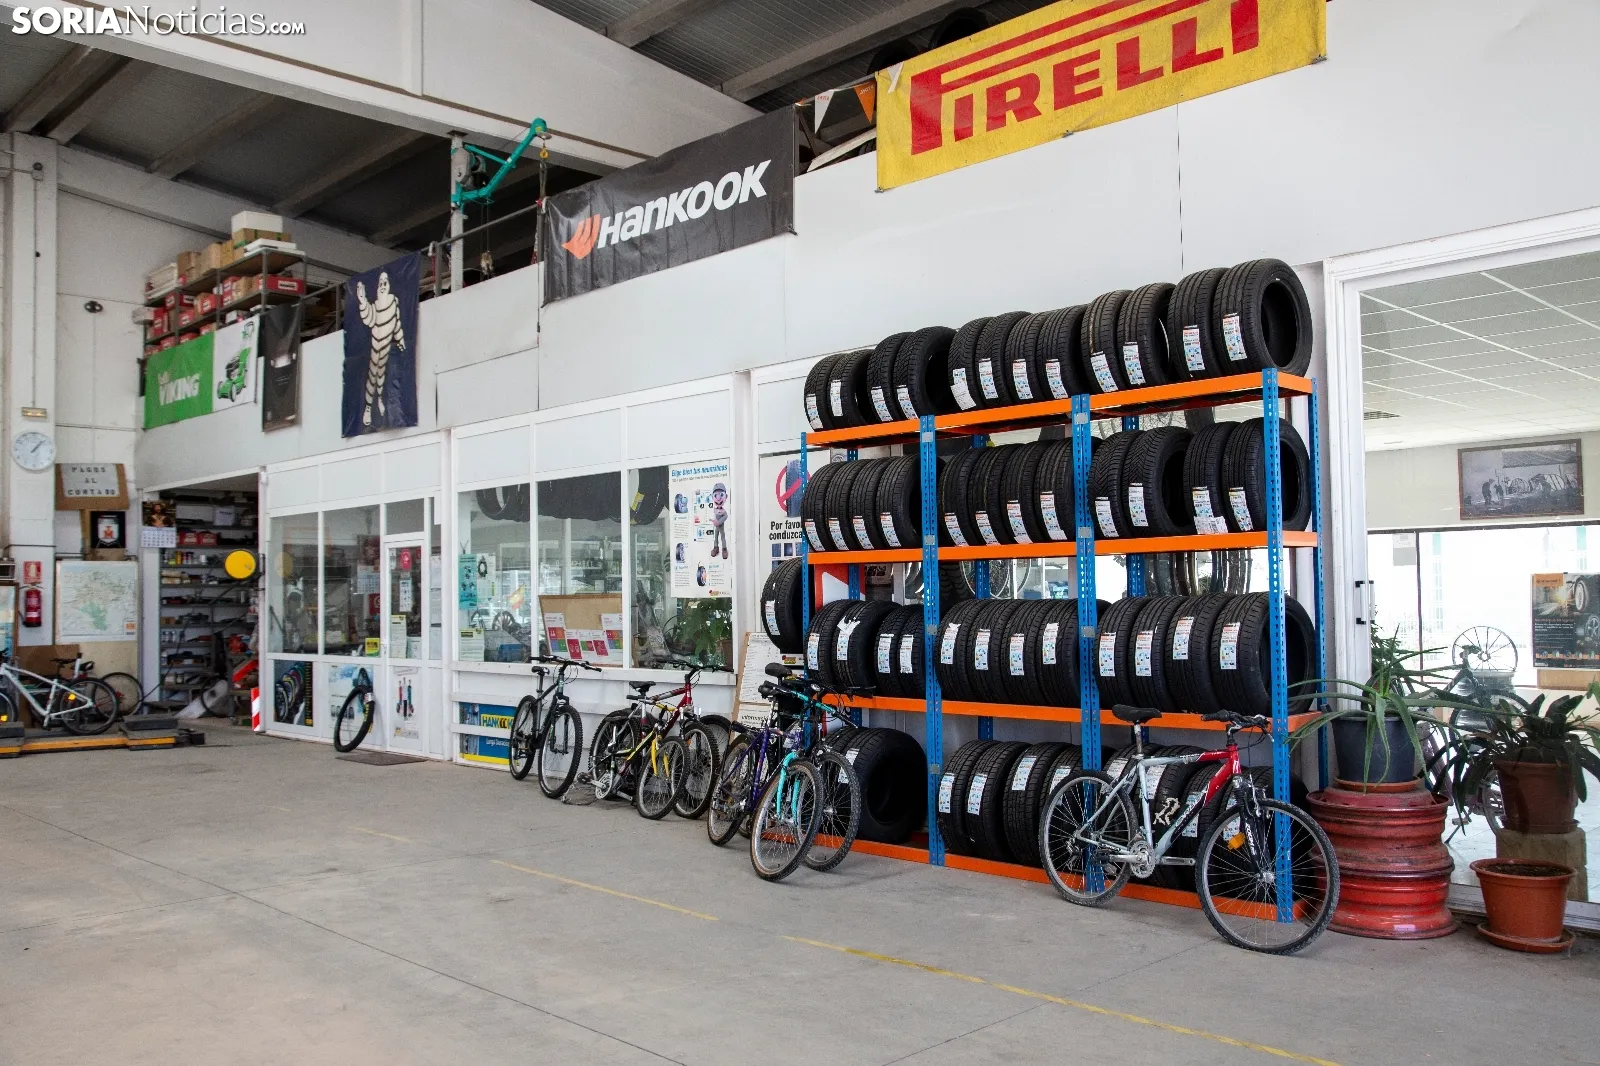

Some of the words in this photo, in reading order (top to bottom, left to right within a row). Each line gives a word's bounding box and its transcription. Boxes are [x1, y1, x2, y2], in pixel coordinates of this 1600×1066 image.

[911, 0, 1259, 155] PIRELLI
[159, 373, 200, 405] VIKING
[770, 521, 783, 530] Por
[784, 519, 802, 529] favo
